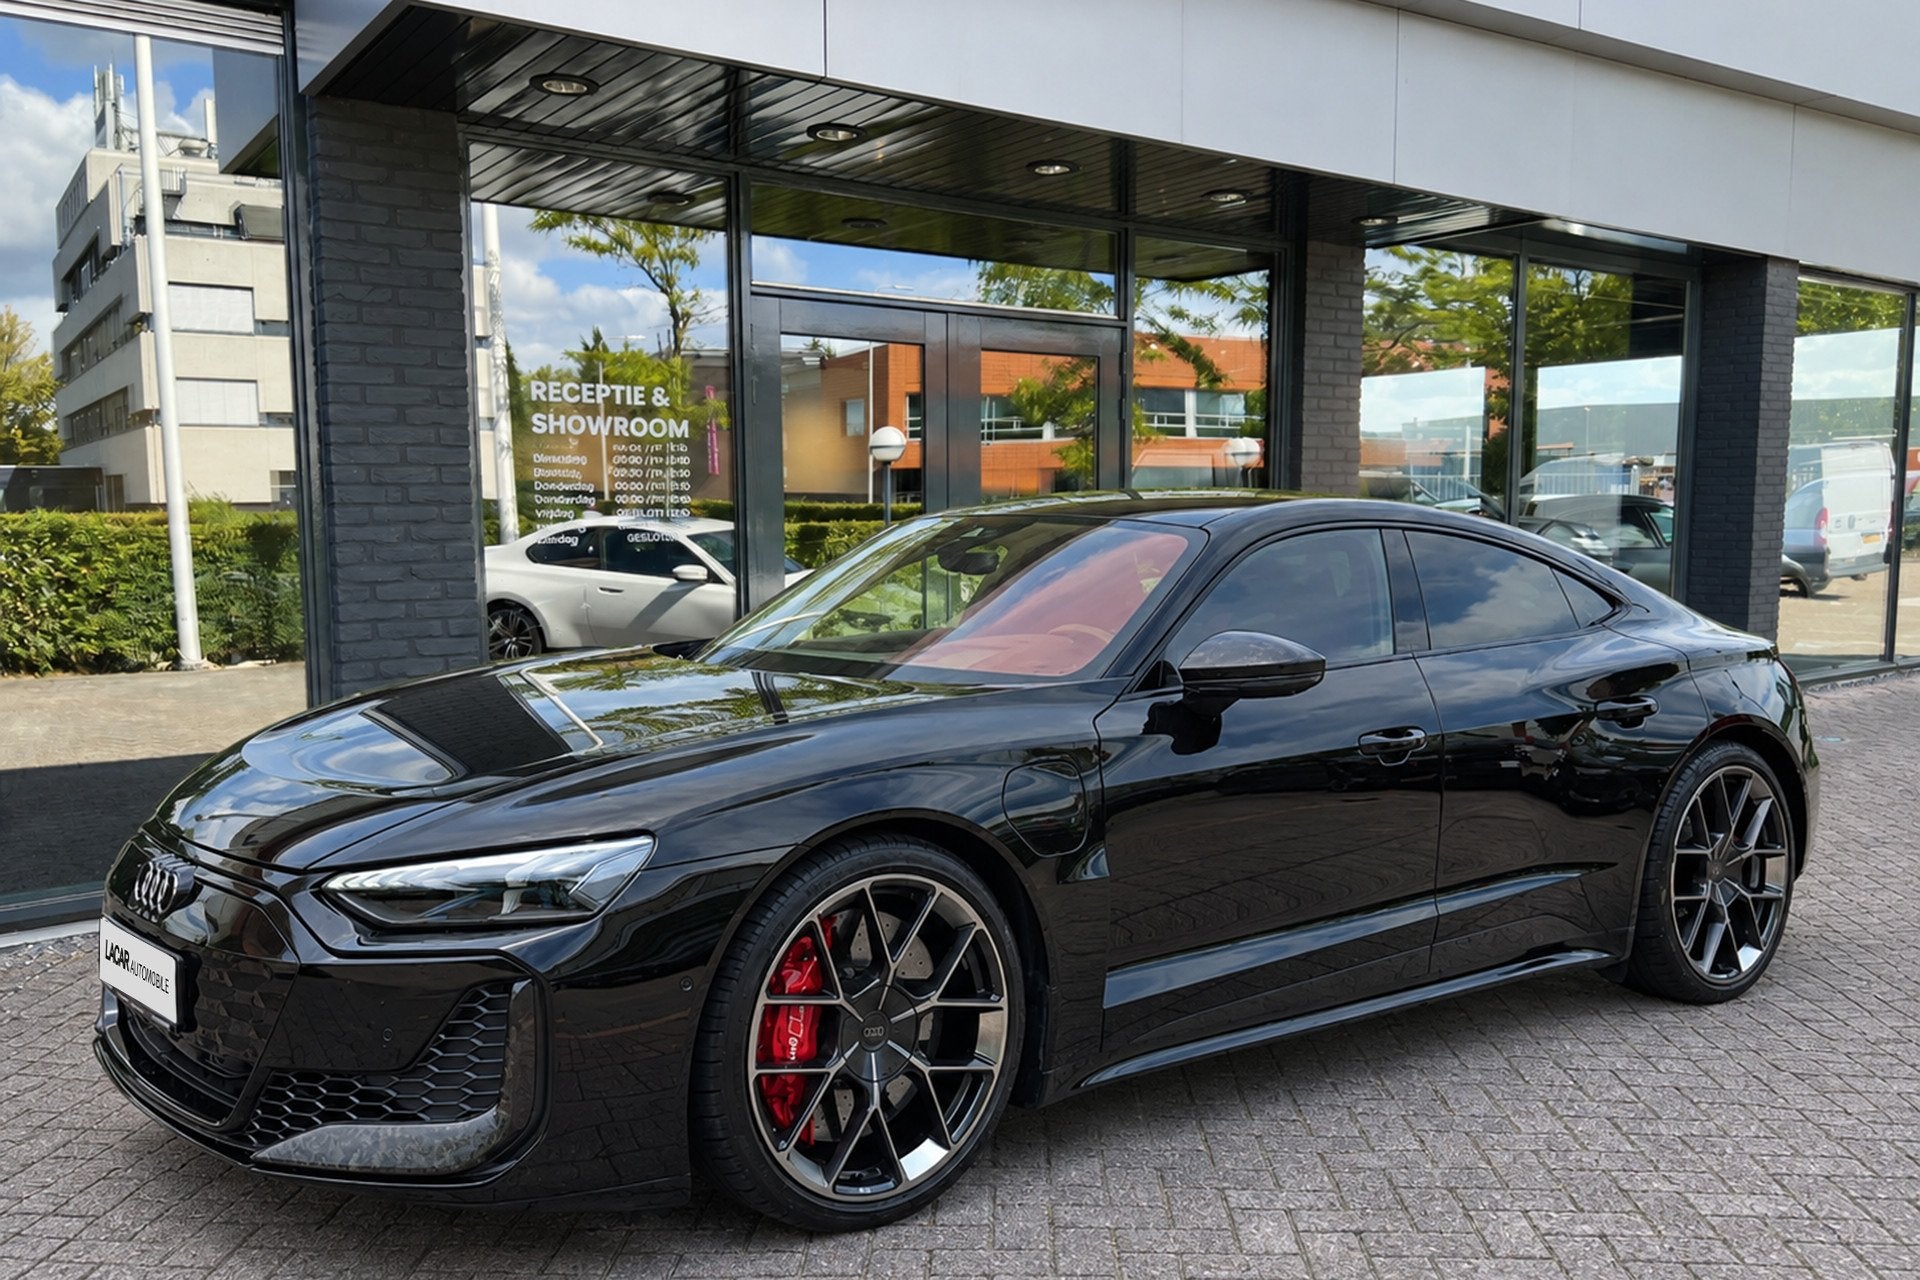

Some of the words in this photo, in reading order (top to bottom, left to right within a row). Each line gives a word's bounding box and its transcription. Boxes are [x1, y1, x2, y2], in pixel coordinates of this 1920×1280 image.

[530, 380, 646, 406] RECEPTIE
[651, 387, 670, 407] &
[531, 413, 690, 439] SHOWROOM
[105, 939, 130, 972] LACAR
[130, 959, 170, 995] AUTOMOBILE
